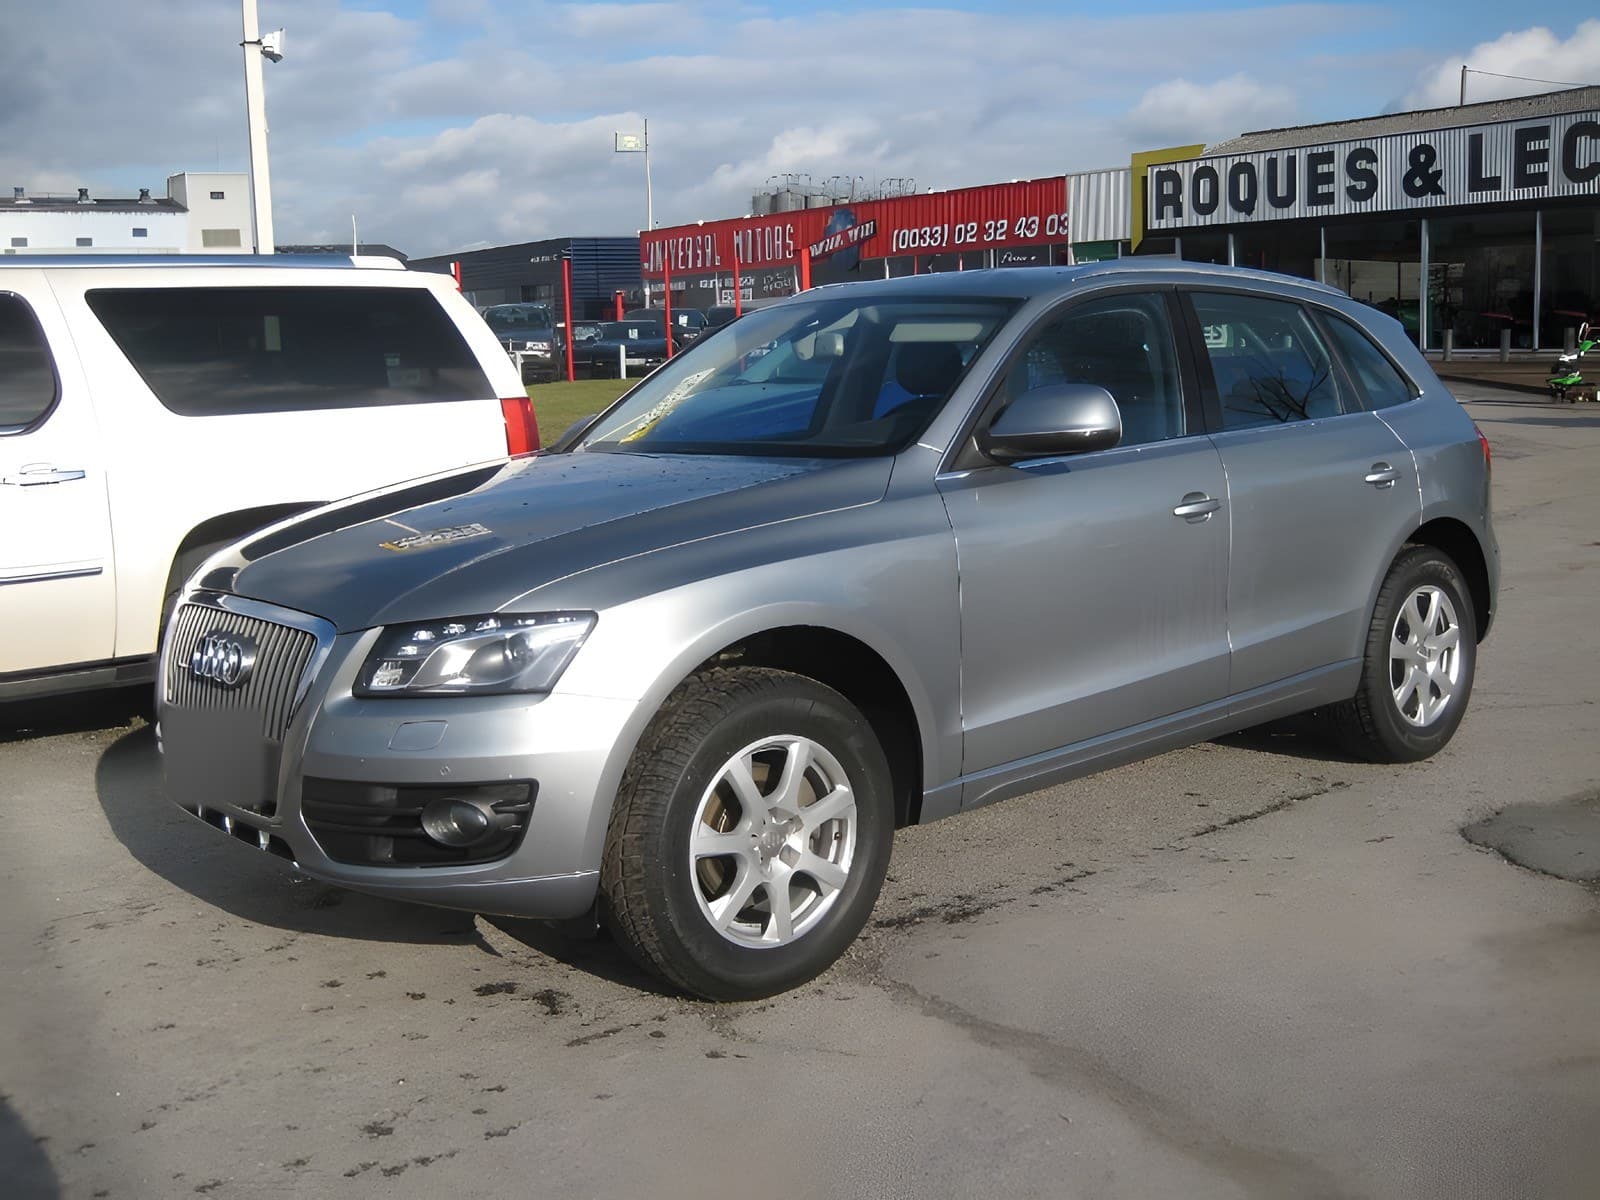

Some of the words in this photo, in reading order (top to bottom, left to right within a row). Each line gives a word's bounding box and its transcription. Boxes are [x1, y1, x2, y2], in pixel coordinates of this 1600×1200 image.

[1155, 147, 1379, 220] ROQUES
[1403, 143, 1446, 198] &
[1468, 121, 1600, 192] LEC
[893, 223, 949, 252] (0033)
[955, 222, 977, 244] 02
[984, 220, 1008, 242] 32
[1014, 216, 1039, 238] 43
[1046, 213, 1068, 236] 03
